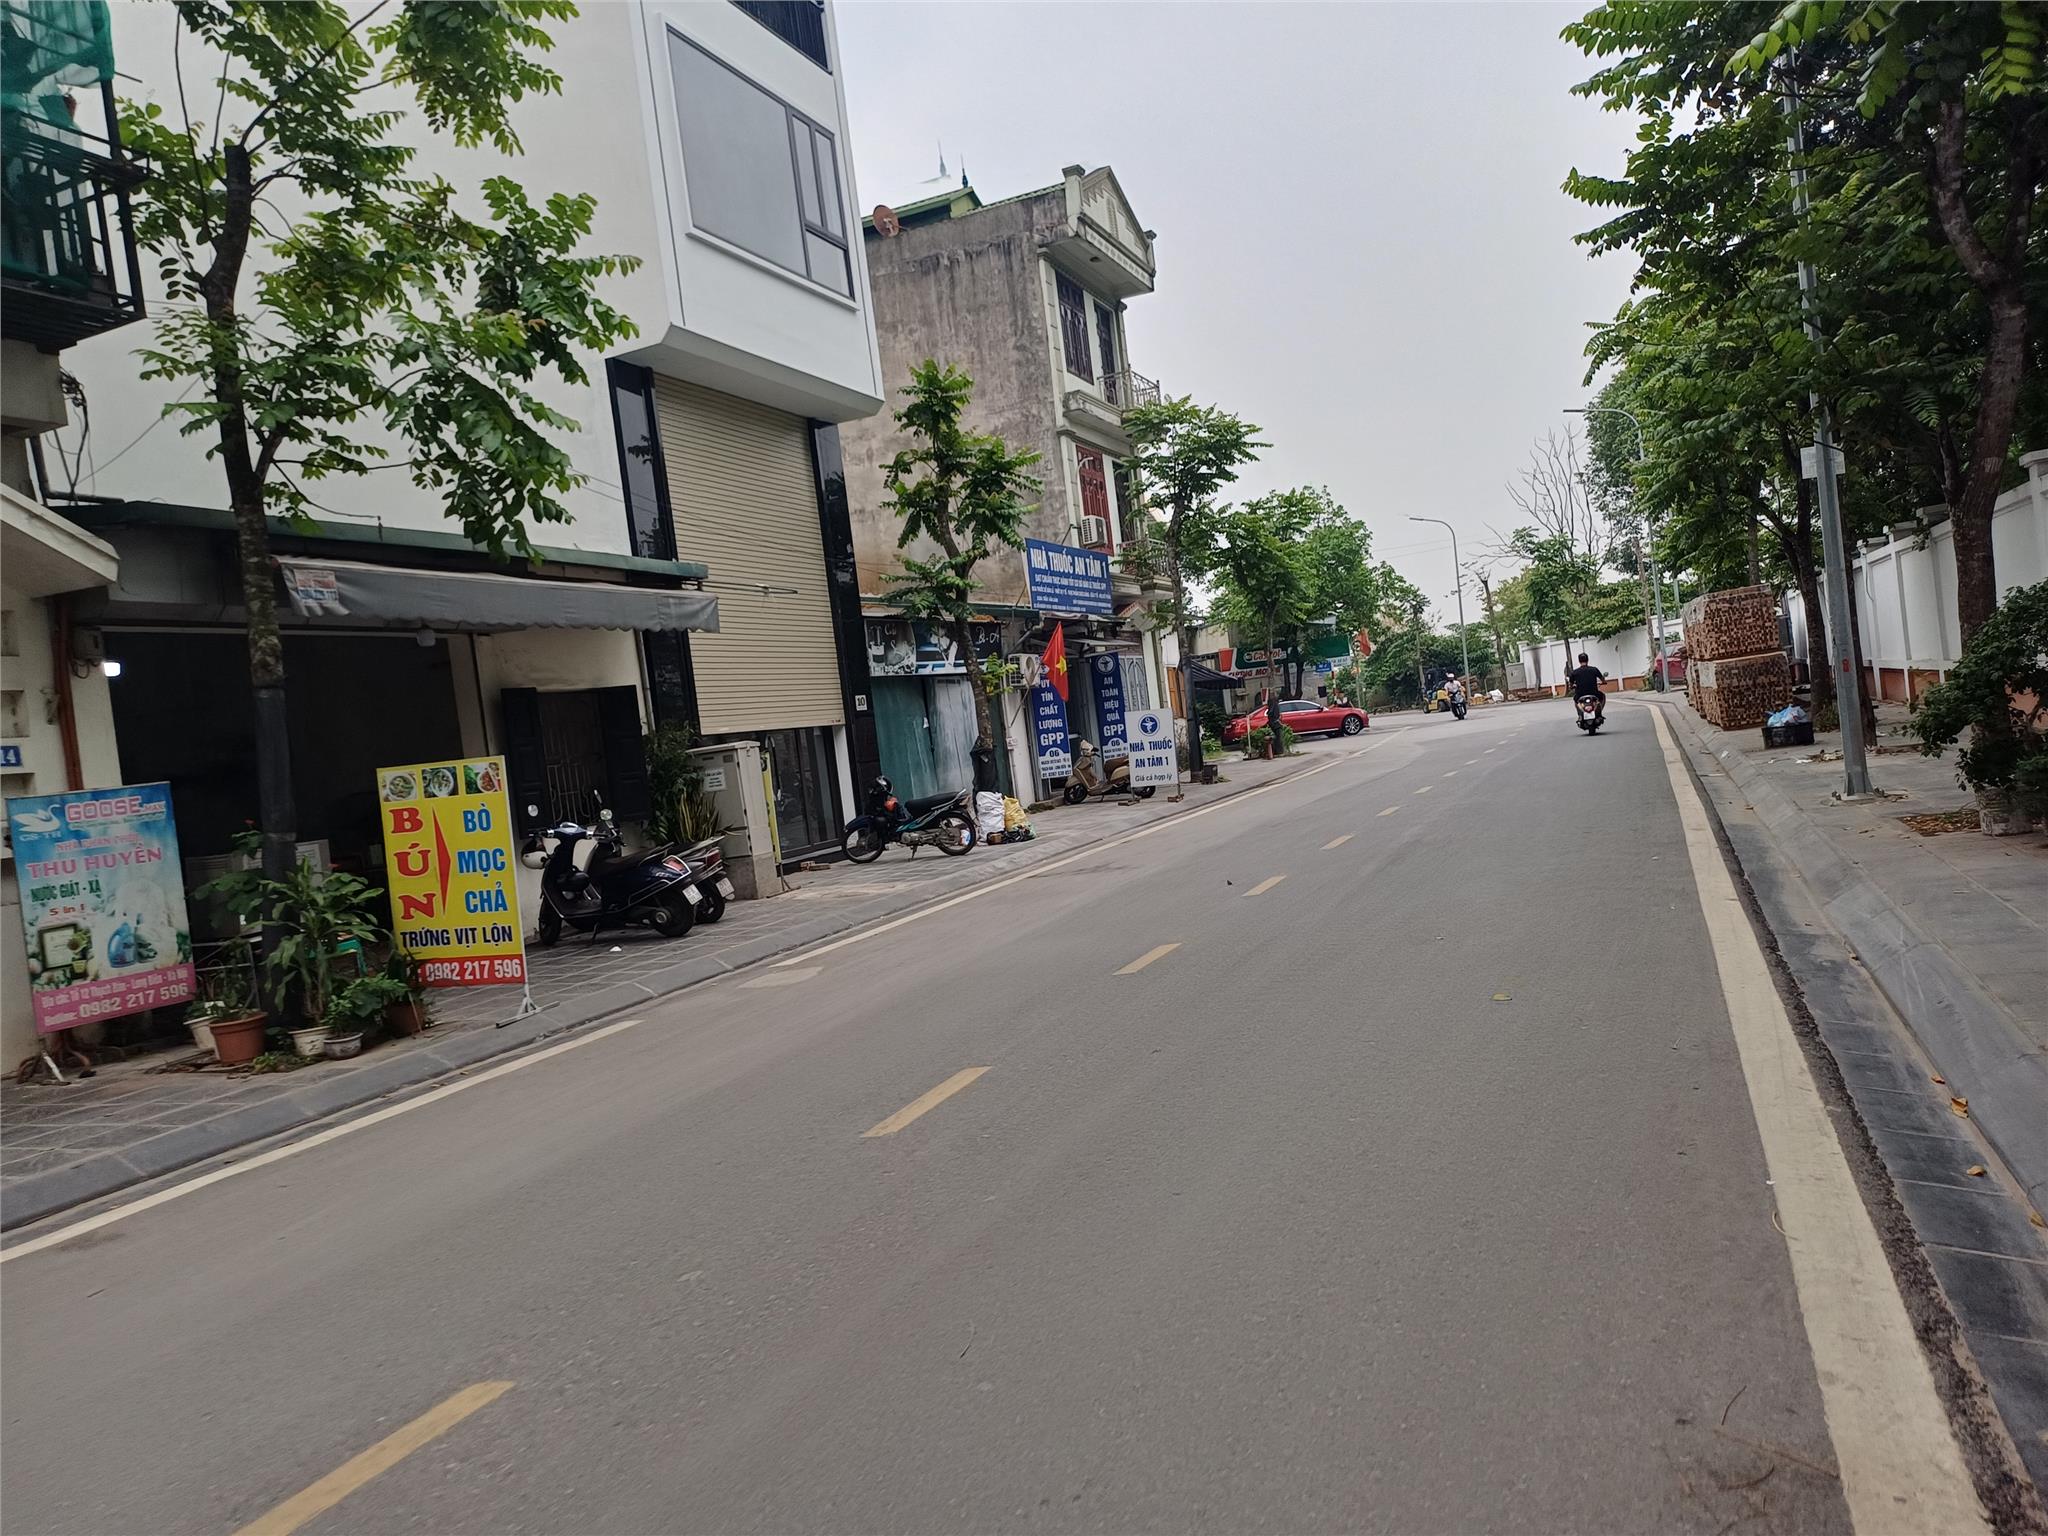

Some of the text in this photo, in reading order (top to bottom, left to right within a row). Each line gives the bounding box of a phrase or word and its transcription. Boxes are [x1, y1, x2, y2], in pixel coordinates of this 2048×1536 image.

[1030, 545, 1107, 579] NHÀ THUỐC AN TÂM 1
[1104, 677, 1113, 685] AN
[1041, 692, 1053, 702] TÍN
[1101, 688, 1119, 698] TOÀN
[857, 697, 865, 706] 10
[1104, 701, 1119, 711] HIỆU
[1039, 705, 1058, 716] CHẤT
[1039, 718, 1062, 731] LƯỢNG
[1103, 723, 1125, 737] GPP
[1040, 732, 1064, 746] GPP
[1129, 740, 1145, 752] NHÀ
[1149, 736, 1172, 751] THUỐC
[1135, 755, 1169, 768] AN TÂM 1
[1135, 774, 1145, 782] Giá
[1154, 773, 1166, 781] hợp
[1167, 773, 1172, 781] lý
[66, 796, 141, 822] GOOSE
[463, 803, 491, 832] BÒ
[27, 842, 162, 879] THU HUYỀN
[457, 848, 506, 877] MỌC
[30, 882, 58, 902] NƯỚC
[60, 880, 80, 900] GIẶT
[88, 874, 102, 894] XẢ
[464, 881, 508, 913] CHẢ
[400, 923, 513, 948] TRỨNG VỊT LỘN
[425, 962, 461, 982] 0982
[464, 960, 490, 979] 217
[494, 959, 522, 979] 596
[79, 998, 122, 1018] 0982
[126, 990, 155, 1008] 217
[160, 983, 188, 1001] 596
